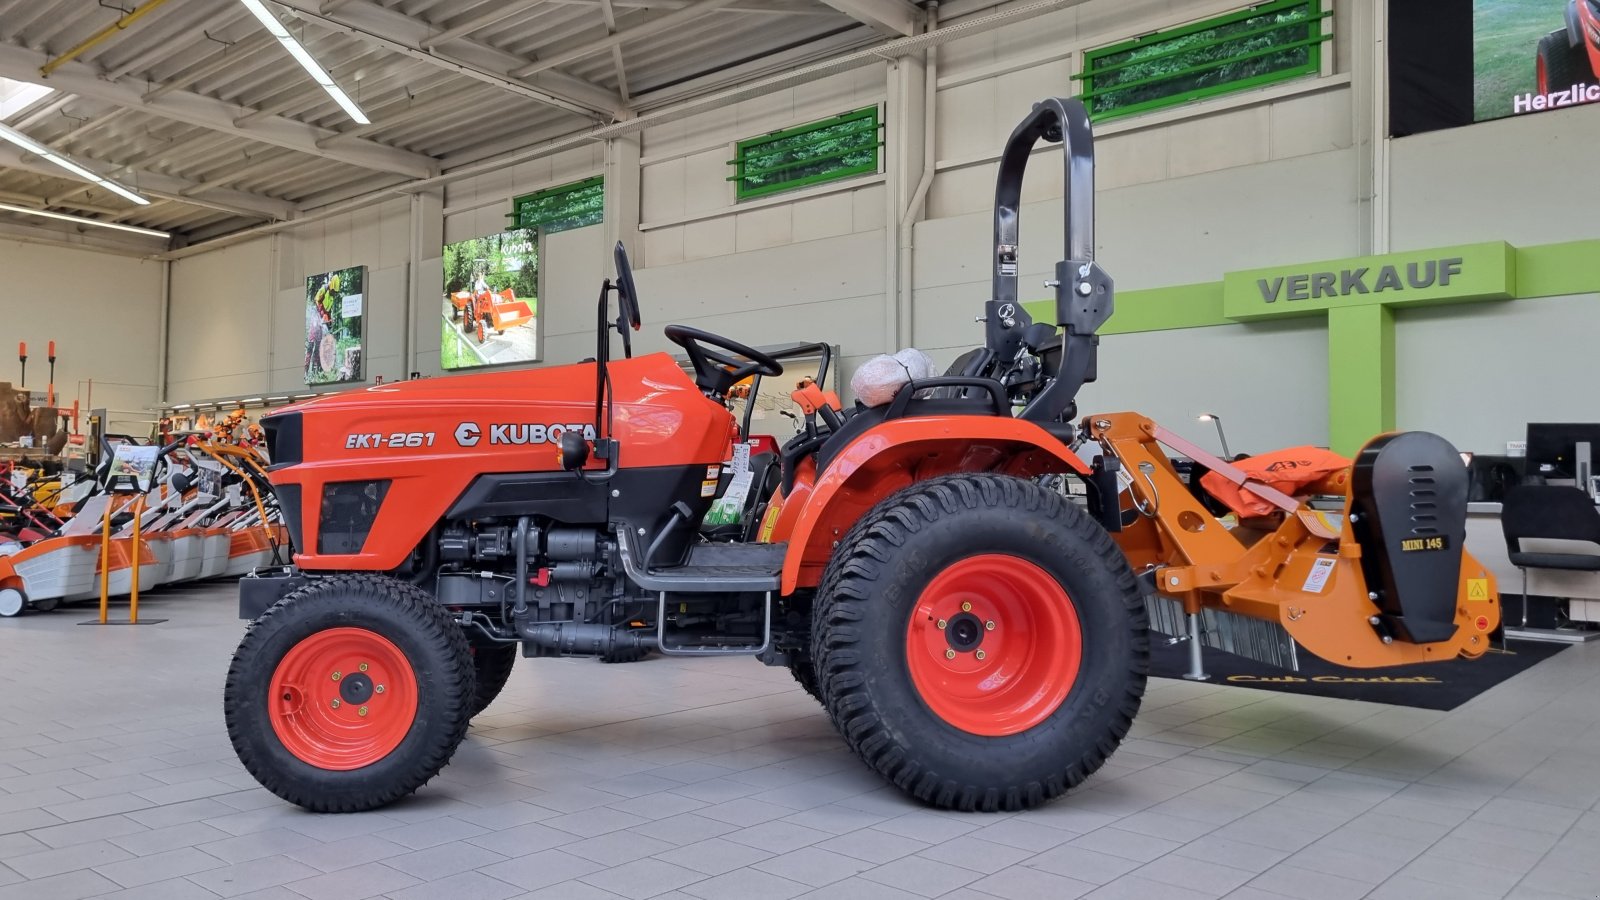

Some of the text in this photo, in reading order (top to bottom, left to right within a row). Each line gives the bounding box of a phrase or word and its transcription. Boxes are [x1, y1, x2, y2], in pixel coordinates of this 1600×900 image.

[1513, 83, 1600, 113] Herzlic
[1257, 257, 1463, 303] VERKAUF
[345, 432, 436, 449] EK1-261
[1402, 537, 1442, 551] MINI 145
[1226, 675, 1442, 683] Cub Cadet
